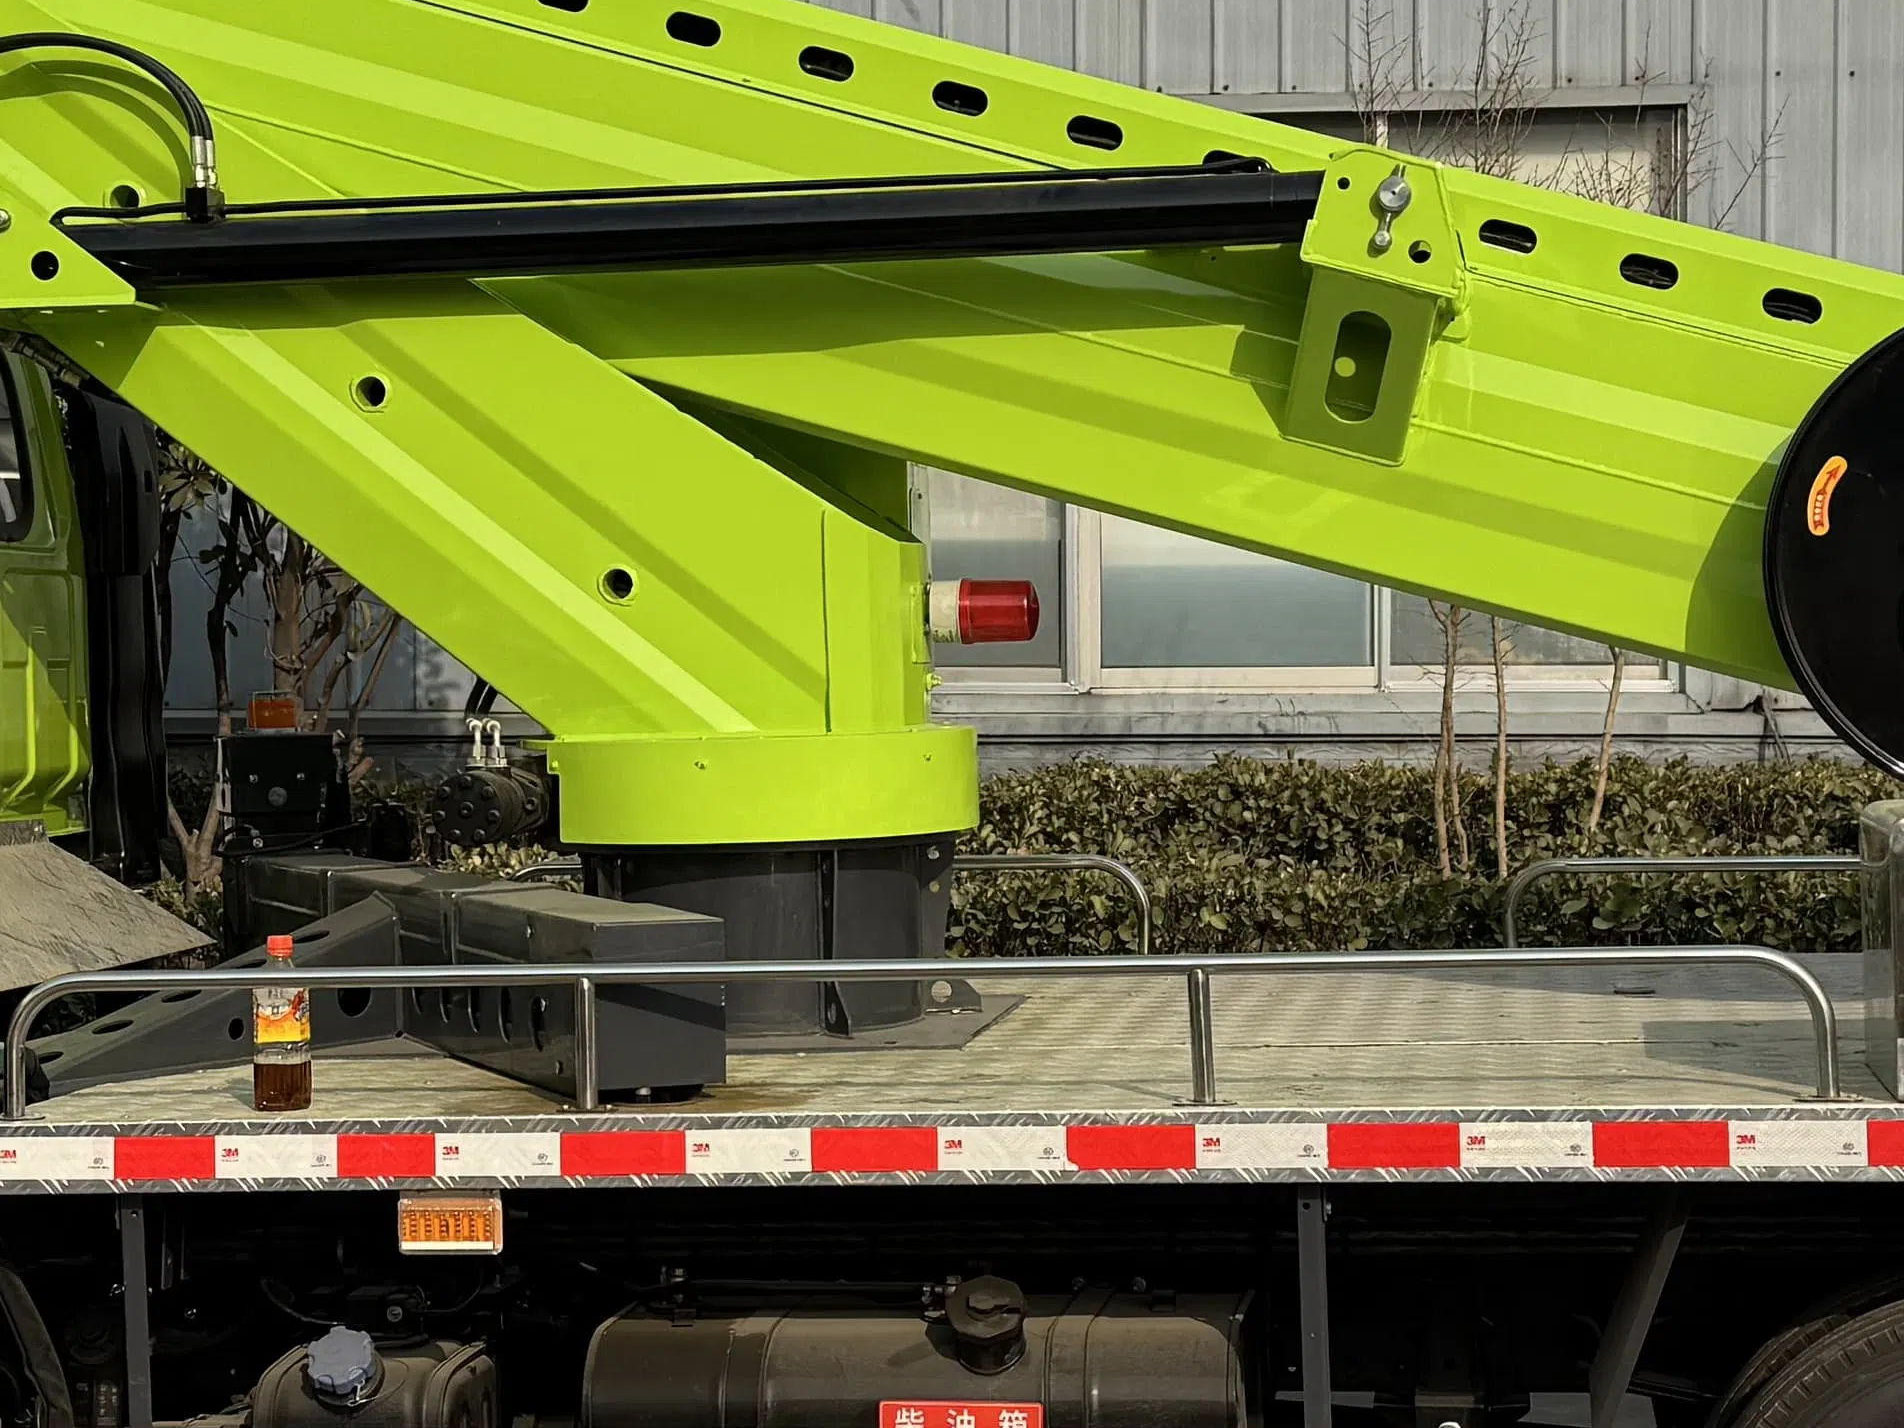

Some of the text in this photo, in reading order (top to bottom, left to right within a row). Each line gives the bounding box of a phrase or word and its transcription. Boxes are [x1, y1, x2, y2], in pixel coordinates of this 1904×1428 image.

[945, 1140, 962, 1149] 3M
[1203, 1138, 1220, 1147] 3M
[1466, 1136, 1485, 1146] 3M
[1736, 1135, 1756, 1145] 3M
